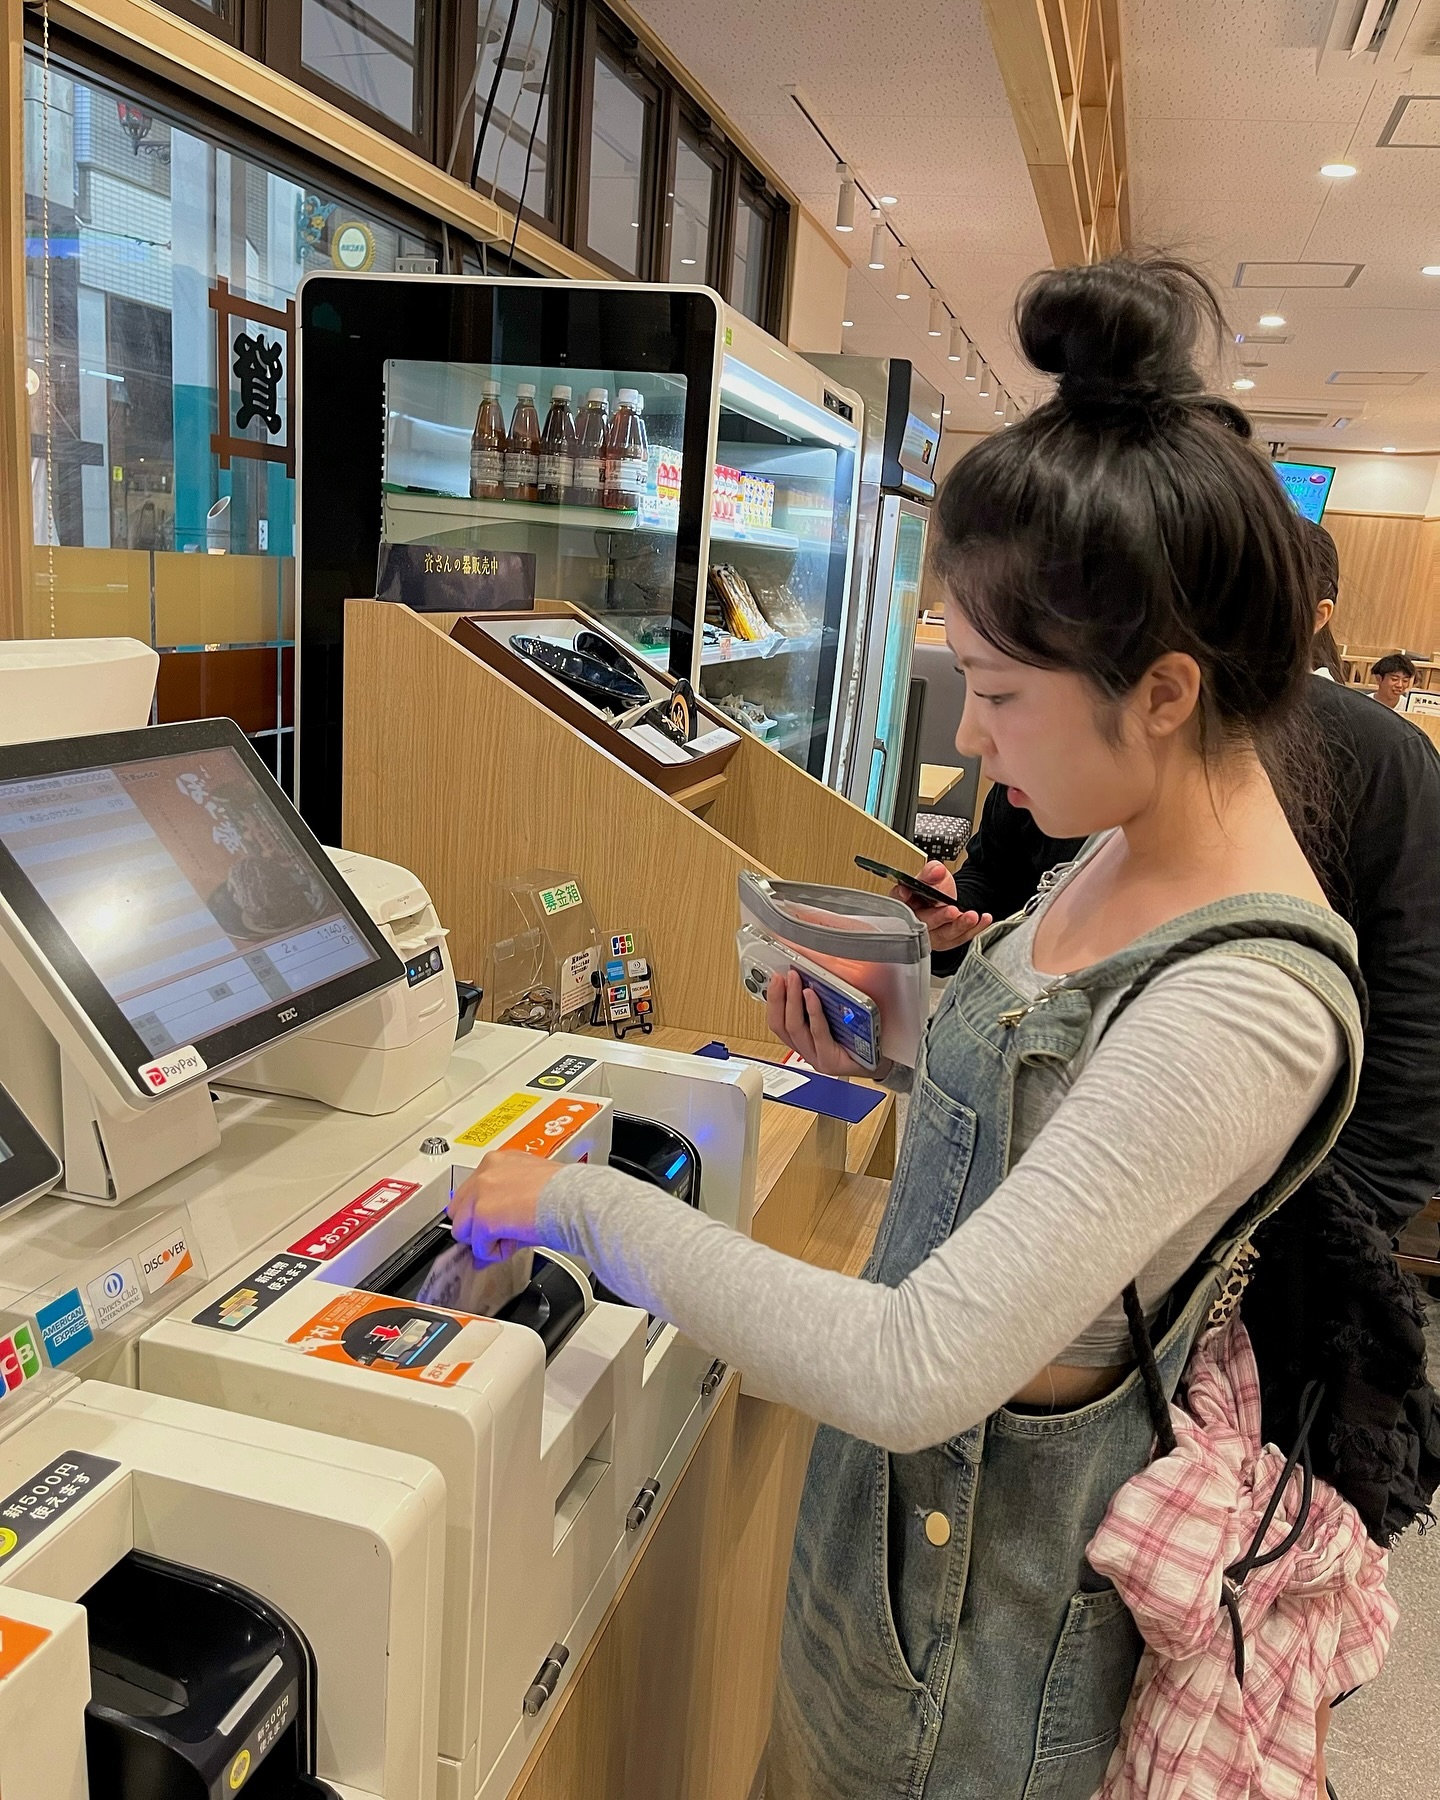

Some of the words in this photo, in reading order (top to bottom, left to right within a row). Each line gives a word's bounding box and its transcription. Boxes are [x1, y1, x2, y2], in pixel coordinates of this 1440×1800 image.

[542, 884, 580, 912] 募金箱
[277, 1007, 298, 1024] TEC
[614, 1008, 628, 1016] VISA
[162, 1056, 199, 1078] PayPay
[524, 1138, 545, 1154] イン
[320, 1218, 360, 1244] おつり
[143, 1240, 186, 1275] DISCOVER
[254, 1261, 290, 1284] 新紙幣
[267, 1262, 308, 1291] 使えます
[98, 1299, 121, 1317] Diners
[121, 1285, 139, 1302] Club
[100, 1295, 140, 1325] INTERNATIONAL
[42, 1306, 84, 1341] AMERICAN
[53, 1317, 89, 1347] EXPRESS
[428, 1363, 451, 1379] お札
[2, 1462, 79, 1519] 新500円
[29, 1472, 91, 1520] 使えます
[257, 1695, 289, 1742] 新500円
[259, 1711, 288, 1754] 使えます
